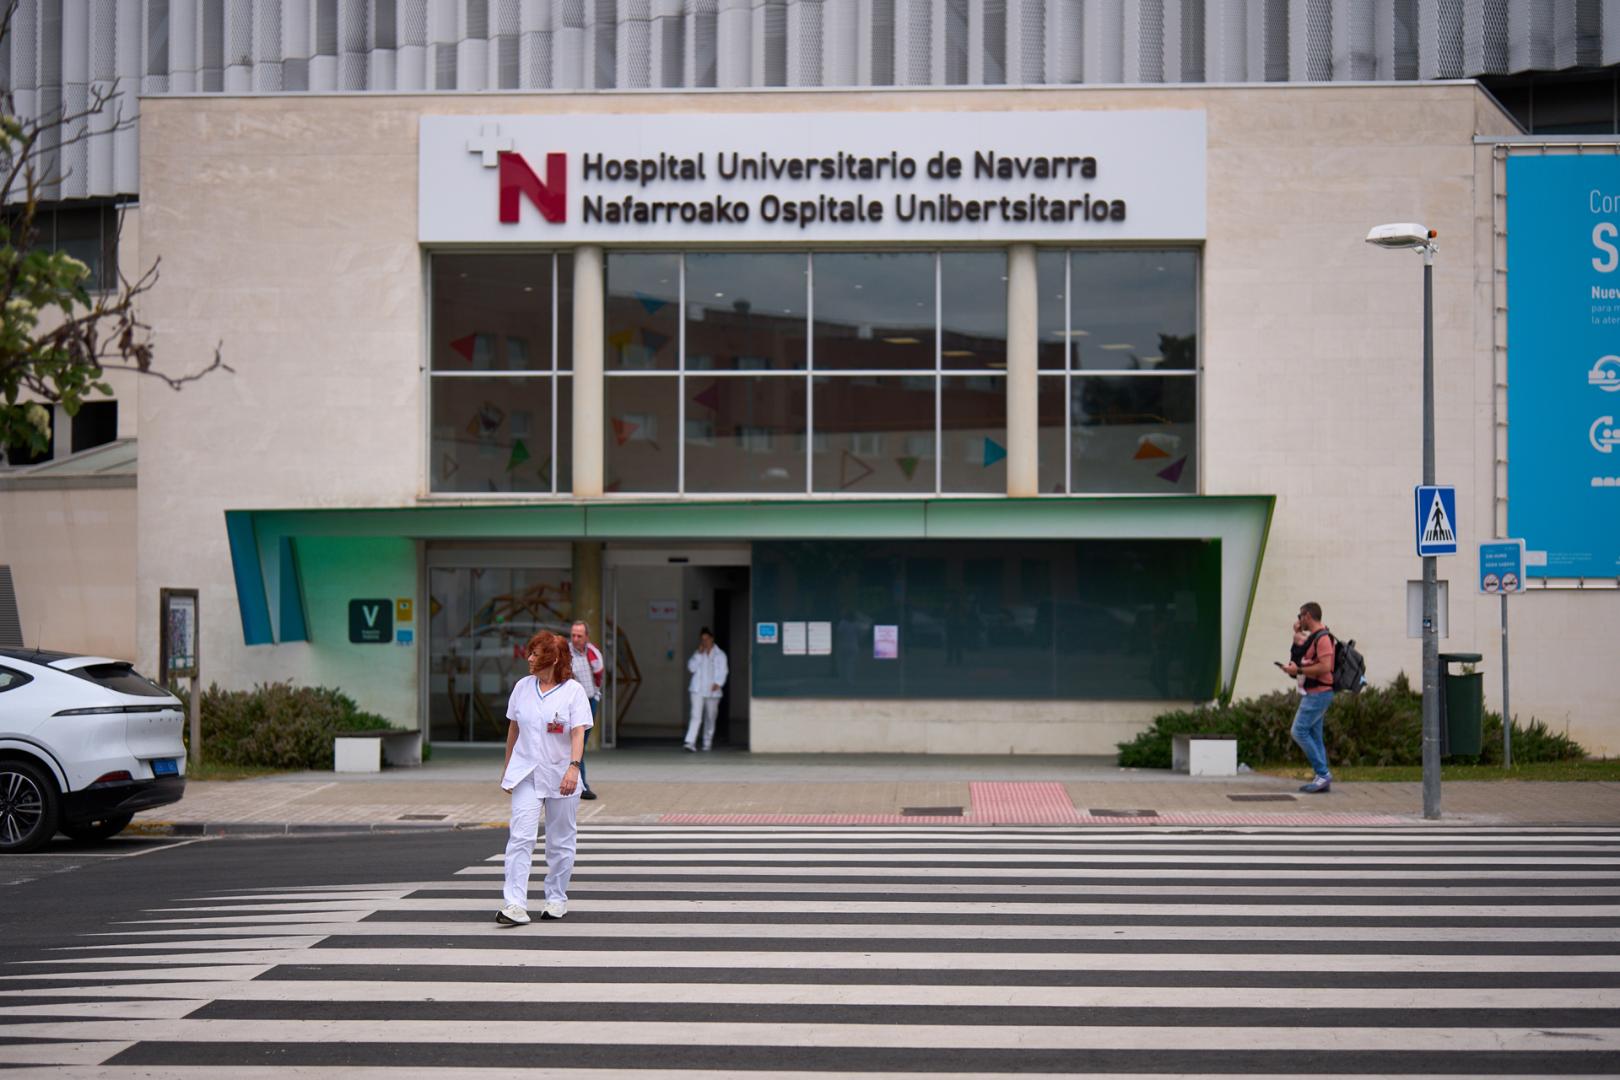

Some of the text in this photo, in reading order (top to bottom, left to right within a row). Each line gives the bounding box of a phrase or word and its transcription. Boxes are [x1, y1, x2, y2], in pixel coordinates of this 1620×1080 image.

[582, 150, 1098, 188] Hospital Universitario de Navarra
[498, 152, 567, 225] N
[582, 192, 1127, 230] Nafarroako Ospitale Unibertsitarioa
[362, 605, 379, 627] V
